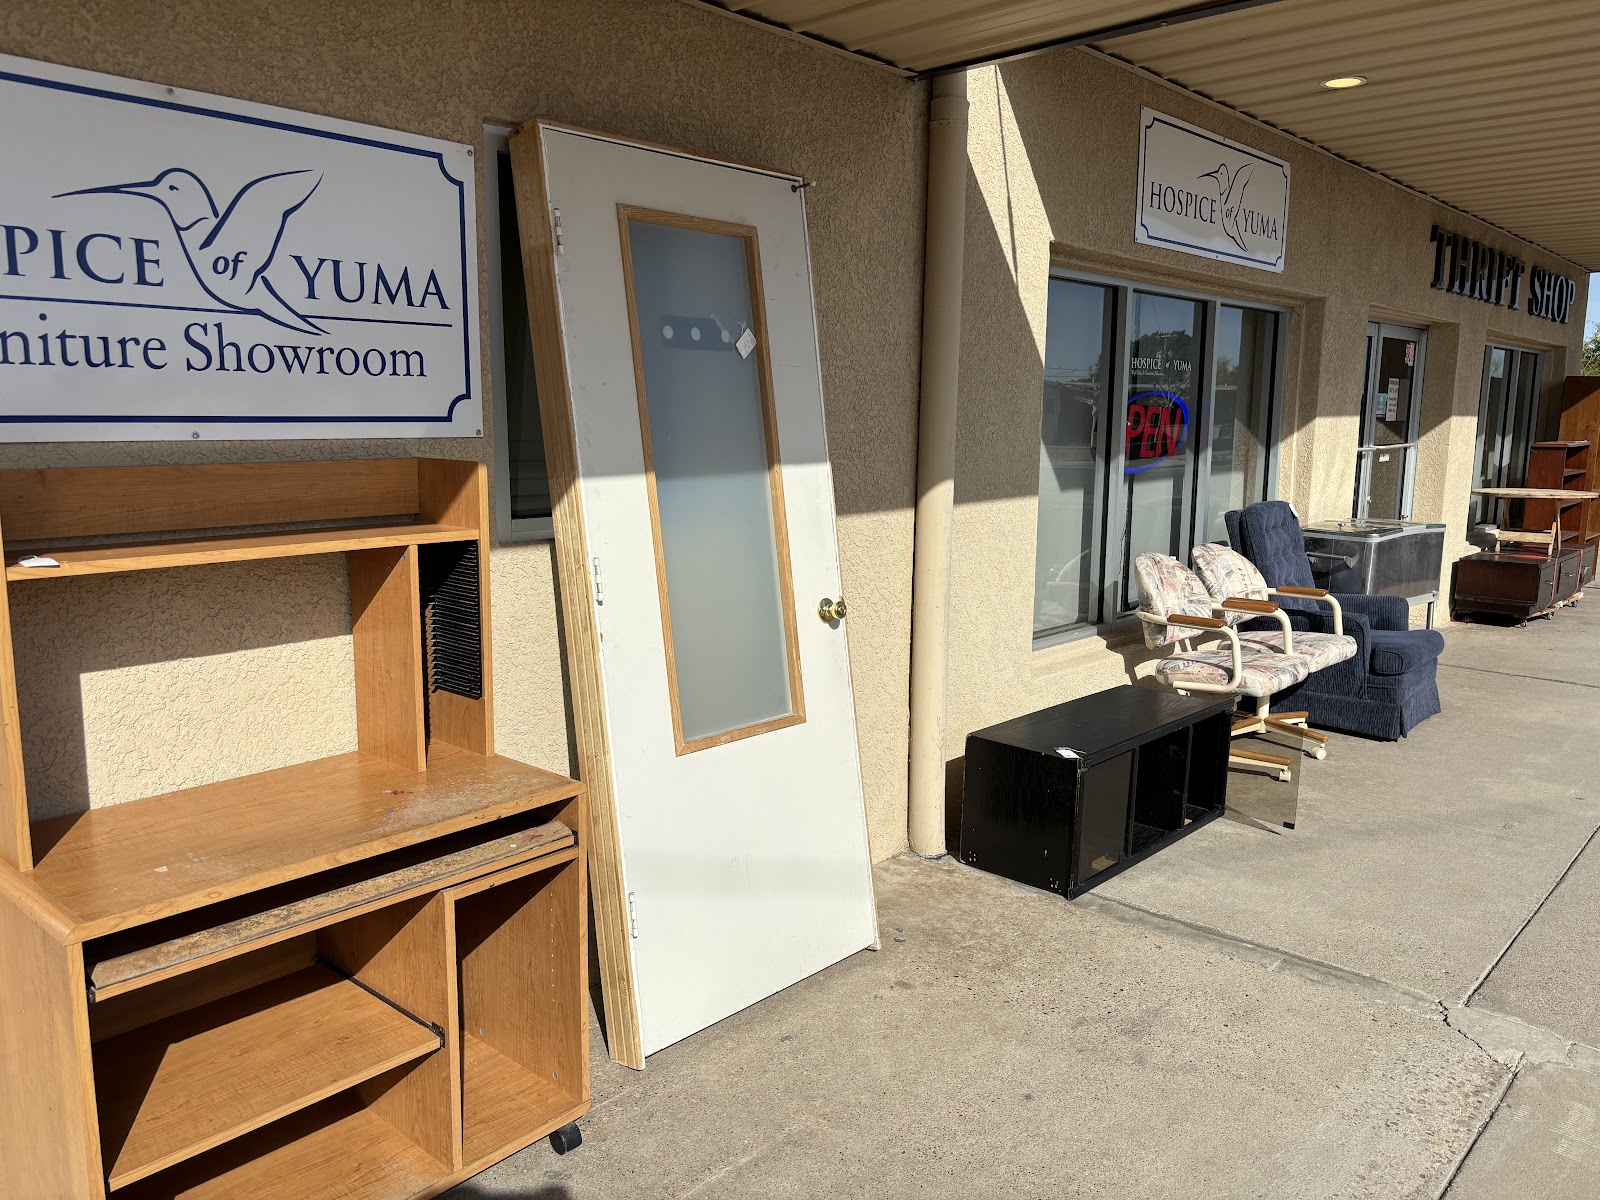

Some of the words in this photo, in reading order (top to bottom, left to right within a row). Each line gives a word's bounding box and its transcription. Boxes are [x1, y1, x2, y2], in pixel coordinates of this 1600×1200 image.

[1149, 181, 1217, 224] HOSPICE
[1225, 206, 1234, 221] of
[1243, 208, 1278, 240] YUMA
[0, 224, 164, 287] PICE
[212, 251, 248, 280] of
[289, 255, 451, 310] YUMA
[1430, 224, 1526, 310] THRIFT
[1528, 265, 1576, 324] SHOP
[0, 313, 168, 370] niture
[184, 322, 427, 377] Showroom
[1131, 357, 1162, 370] HOSPICE
[1173, 360, 1192, 372] YUMA
